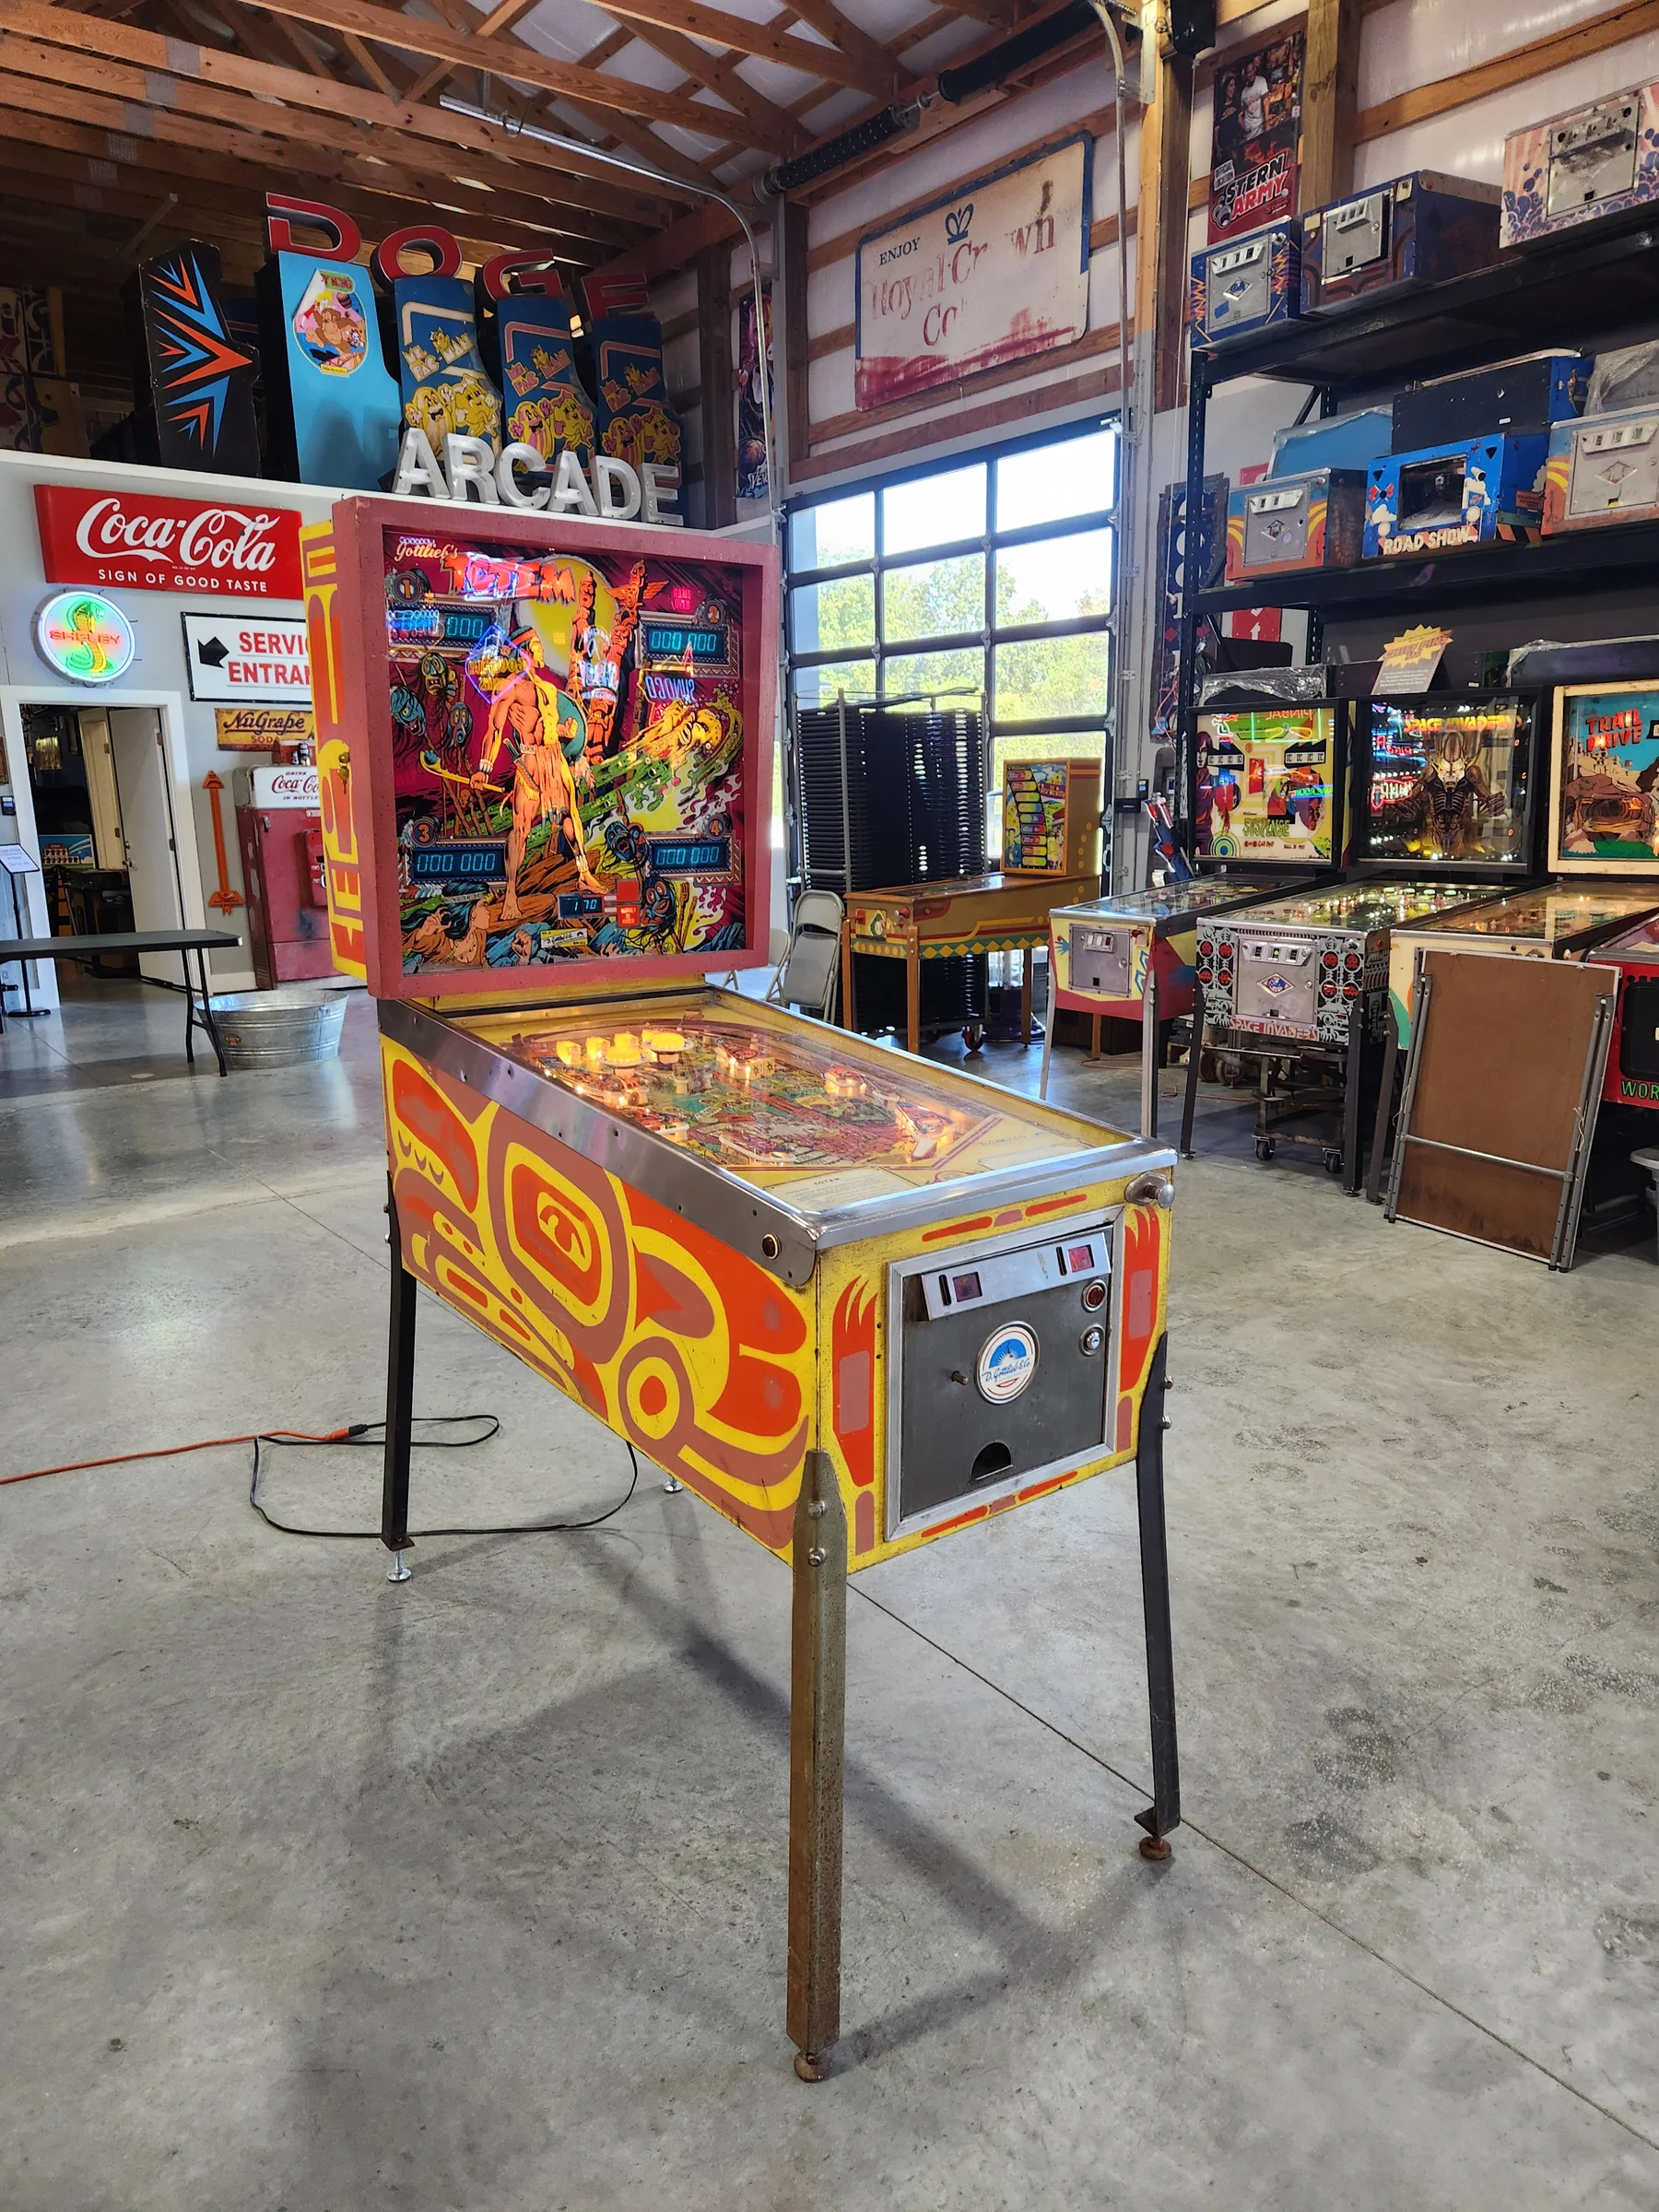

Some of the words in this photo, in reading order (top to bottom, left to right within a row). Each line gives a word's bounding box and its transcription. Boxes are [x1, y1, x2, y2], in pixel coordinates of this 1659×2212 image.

[1226, 154, 1285, 203] STERN
[1232, 171, 1288, 218] ARMY
[879, 238, 921, 265] ENJOY
[951, 214, 1055, 284] Crwn
[392, 427, 684, 526] ARCADE
[76, 498, 280, 571] Coca-Cola
[1382, 532, 1425, 556] ROAD
[1428, 524, 1472, 548] SHOW
[98, 569, 137, 582] SIGN
[146, 572, 166, 584] OF
[174, 574, 220, 589] GOOD
[226, 579, 268, 593] TASTE
[444, 555, 576, 605] TOTEM
[673, 587, 691, 600] GAME
[674, 599, 691, 610] OVER
[50, 629, 121, 644] SHELBY
[239, 631, 309, 655] SERVI
[223, 711, 305, 735] NuGrape
[1403, 717, 1442, 733] SPACE
[1445, 715, 1523, 732] INVADERS
[1585, 708, 1642, 735] TRAIL
[1586, 725, 1642, 751] DRIVE
[418, 824, 429, 842] 3
[711, 820, 720, 836] 4
[1242, 818, 1290, 838] SUSPENSE
[417, 854, 453, 872] 000
[460, 853, 496, 871] 000
[1229, 1018, 1261, 1033] SPACE
[1264, 1023, 1318, 1041] INVADERS
